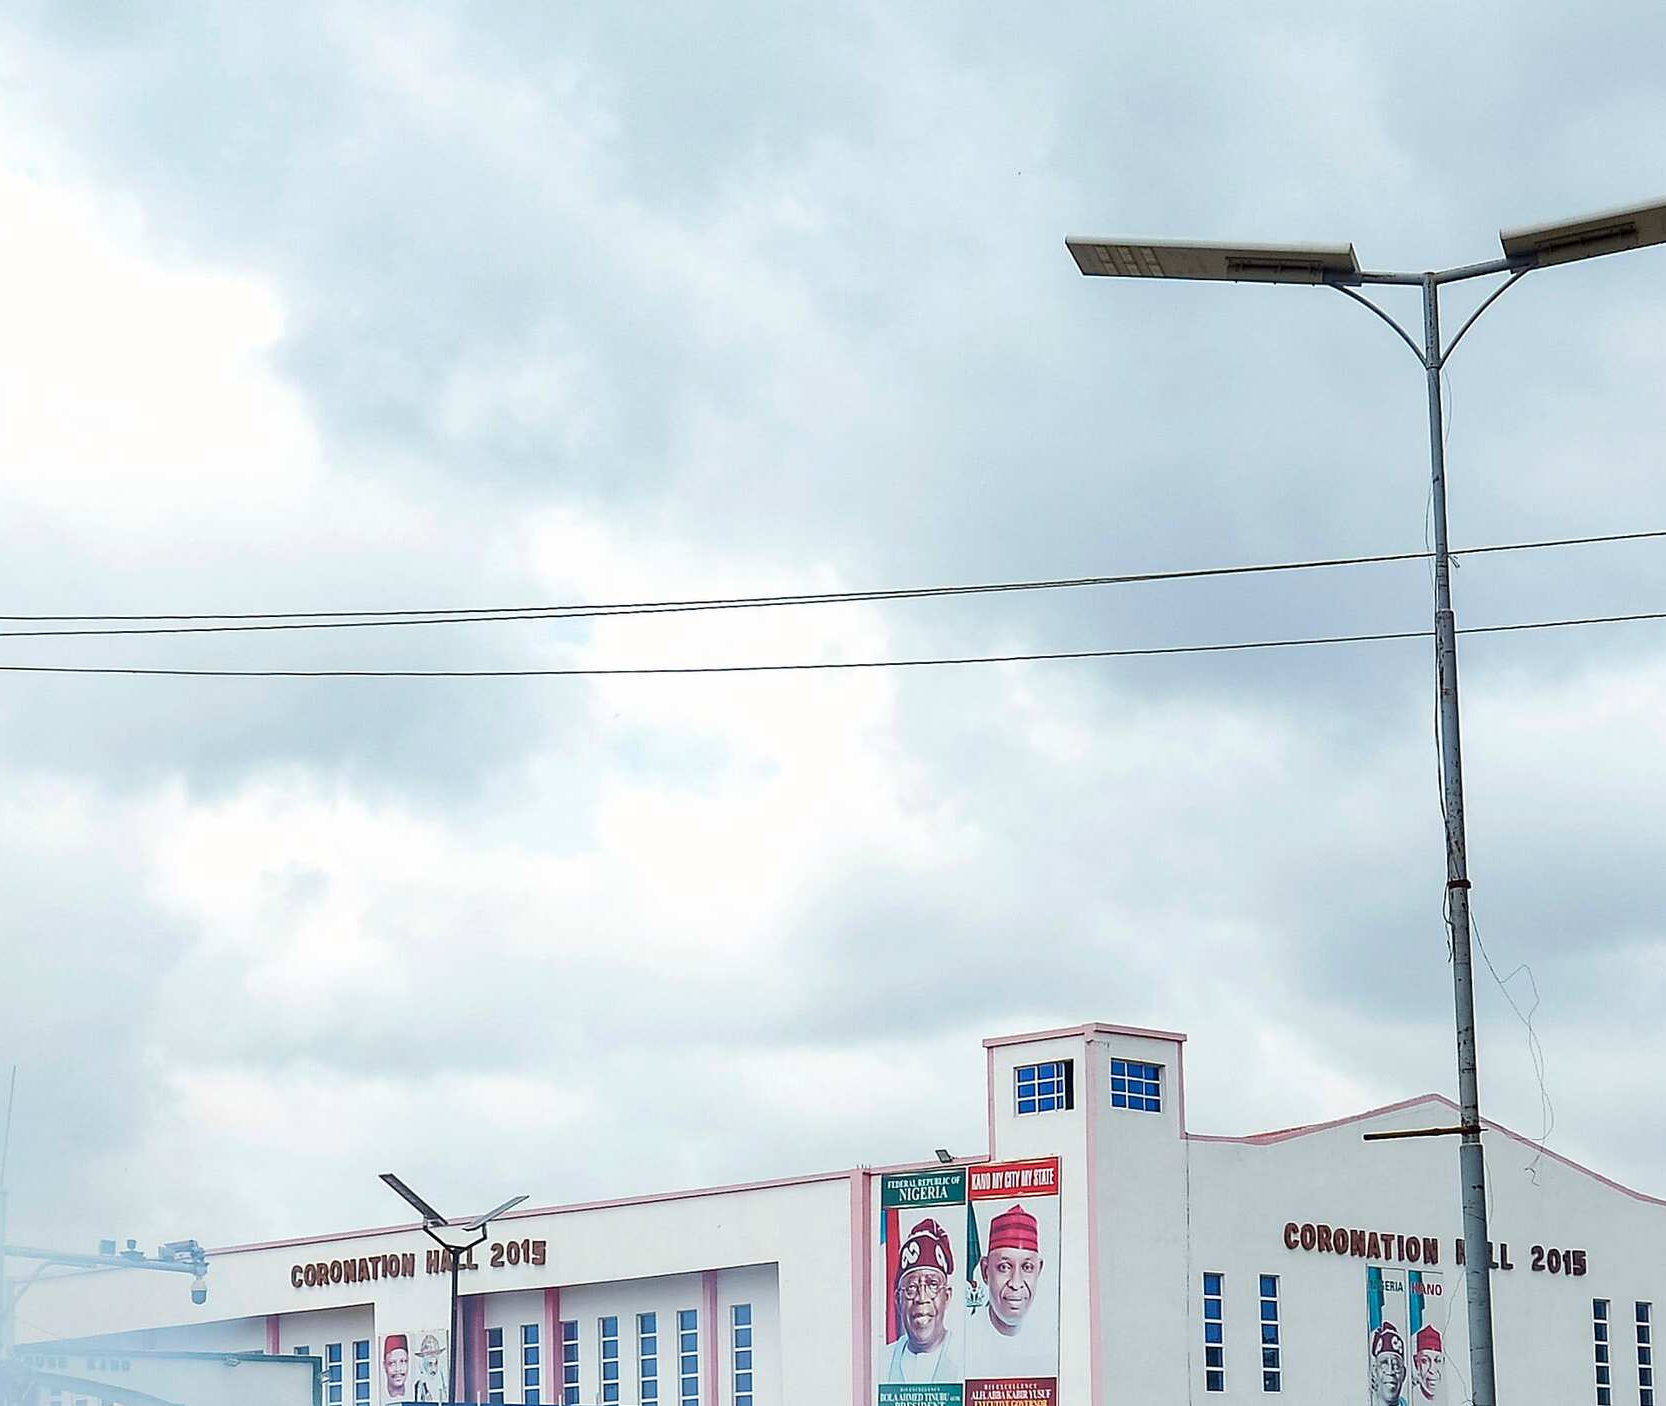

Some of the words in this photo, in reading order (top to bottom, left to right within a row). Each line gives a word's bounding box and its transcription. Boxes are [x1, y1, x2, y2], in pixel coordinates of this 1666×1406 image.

[887, 1179, 916, 1189] FEDERAL
[917, 1176, 950, 1187] REPUBLIC
[951, 1175, 961, 1185] OF
[971, 1172, 991, 1190] KANO
[992, 1171, 1004, 1189] MY
[1004, 1170, 1020, 1188] CITY
[1021, 1169, 1032, 1187] MY
[1033, 1167, 1054, 1186] STATE
[899, 1185, 948, 1201] NIGERIA
[1284, 1222, 1439, 1265] CORONATION
[1455, 1237, 1514, 1271] HLL
[1530, 1245, 1587, 1277] 2015
[291, 1253, 415, 1288] CORONATION
[490, 1239, 547, 1268] 2015
